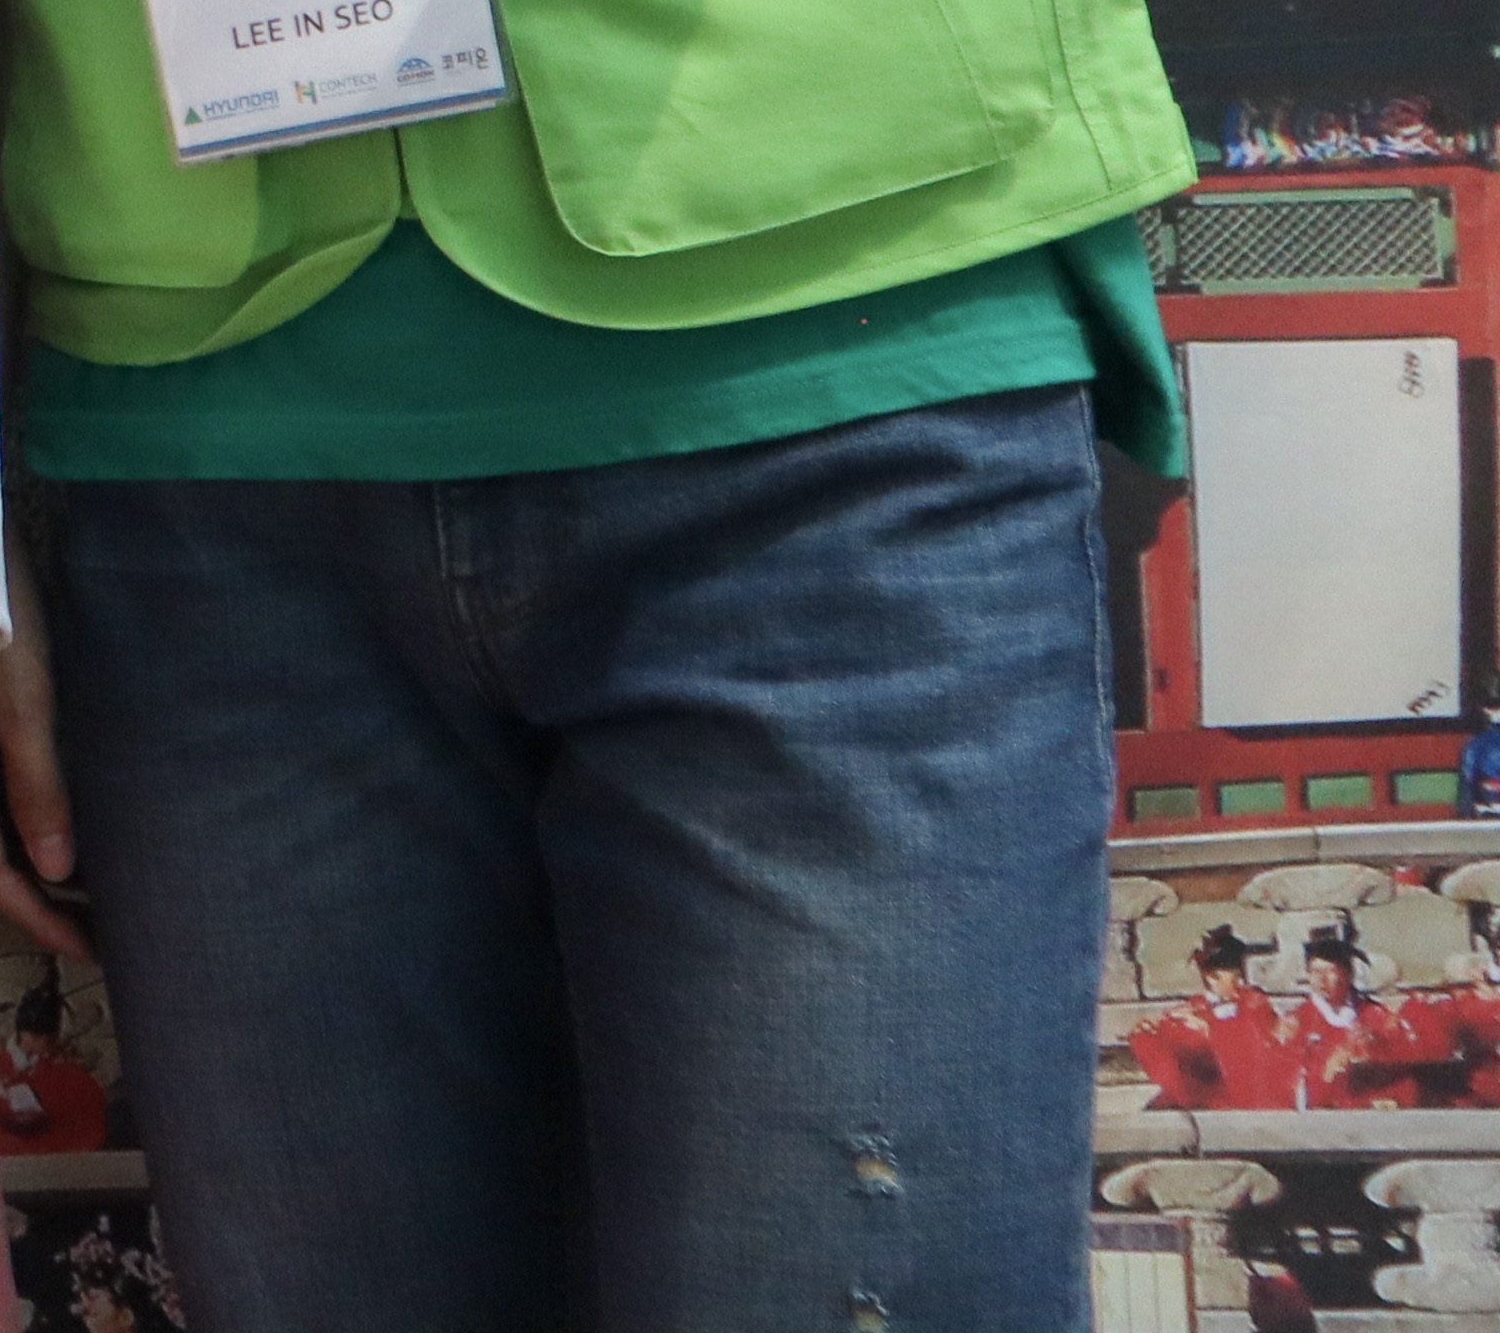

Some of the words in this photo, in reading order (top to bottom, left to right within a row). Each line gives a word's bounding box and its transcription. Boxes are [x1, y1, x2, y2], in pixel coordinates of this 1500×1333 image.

[232, 18, 286, 50] LEE
[295, 10, 325, 38] IN
[203, 90, 280, 116] HYUNDAI
[442, 47, 489, 70] 코피온
